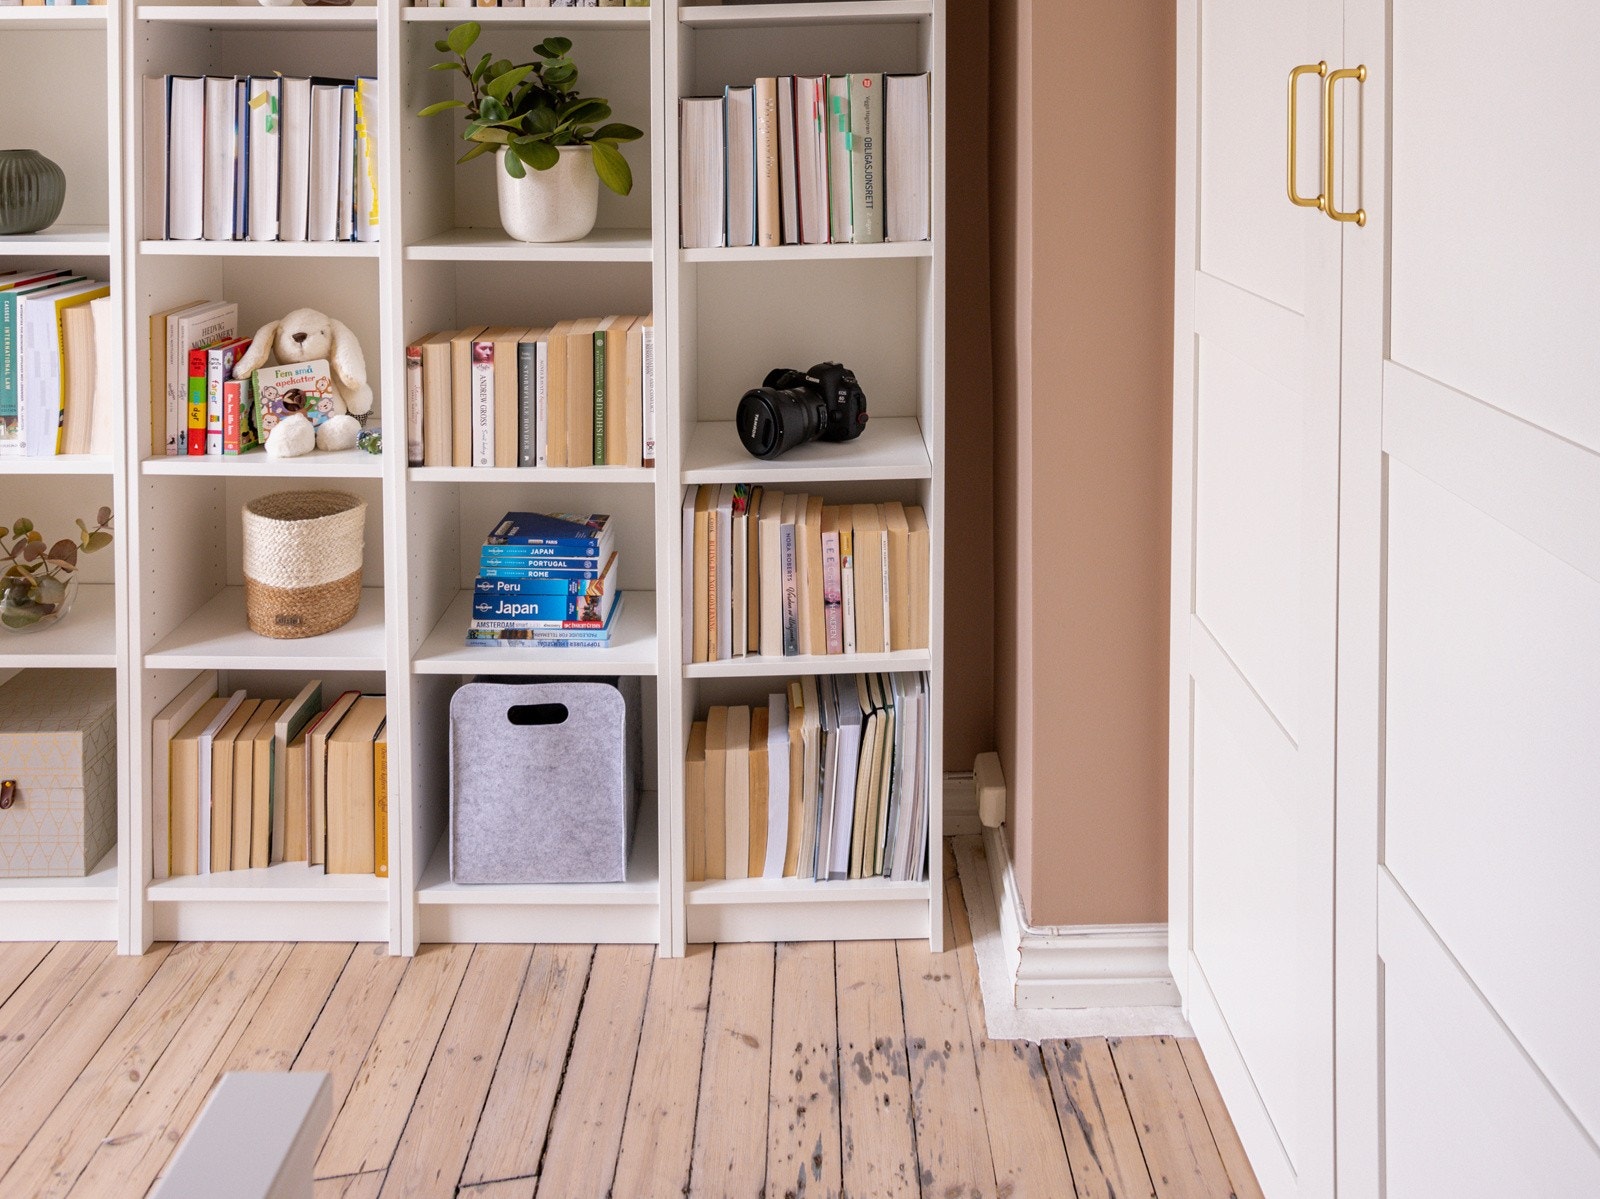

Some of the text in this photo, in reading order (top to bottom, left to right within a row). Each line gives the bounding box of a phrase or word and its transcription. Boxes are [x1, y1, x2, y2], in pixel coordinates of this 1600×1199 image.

[864, 137, 874, 209] OBLIGASJONSRETT
[275, 365, 314, 379] Fem små
[806, 375, 820, 383] Canon
[276, 376, 315, 388] apekatter
[480, 374, 488, 404] ANDREW
[210, 380, 220, 404] farger
[192, 407, 200, 421] dyr
[480, 405, 488, 427] GROSS
[595, 389, 604, 436] ISHIGURO
[826, 539, 836, 598] LEE CHILD
[497, 581, 520, 591] Peru
[495, 600, 538, 617] Japan
